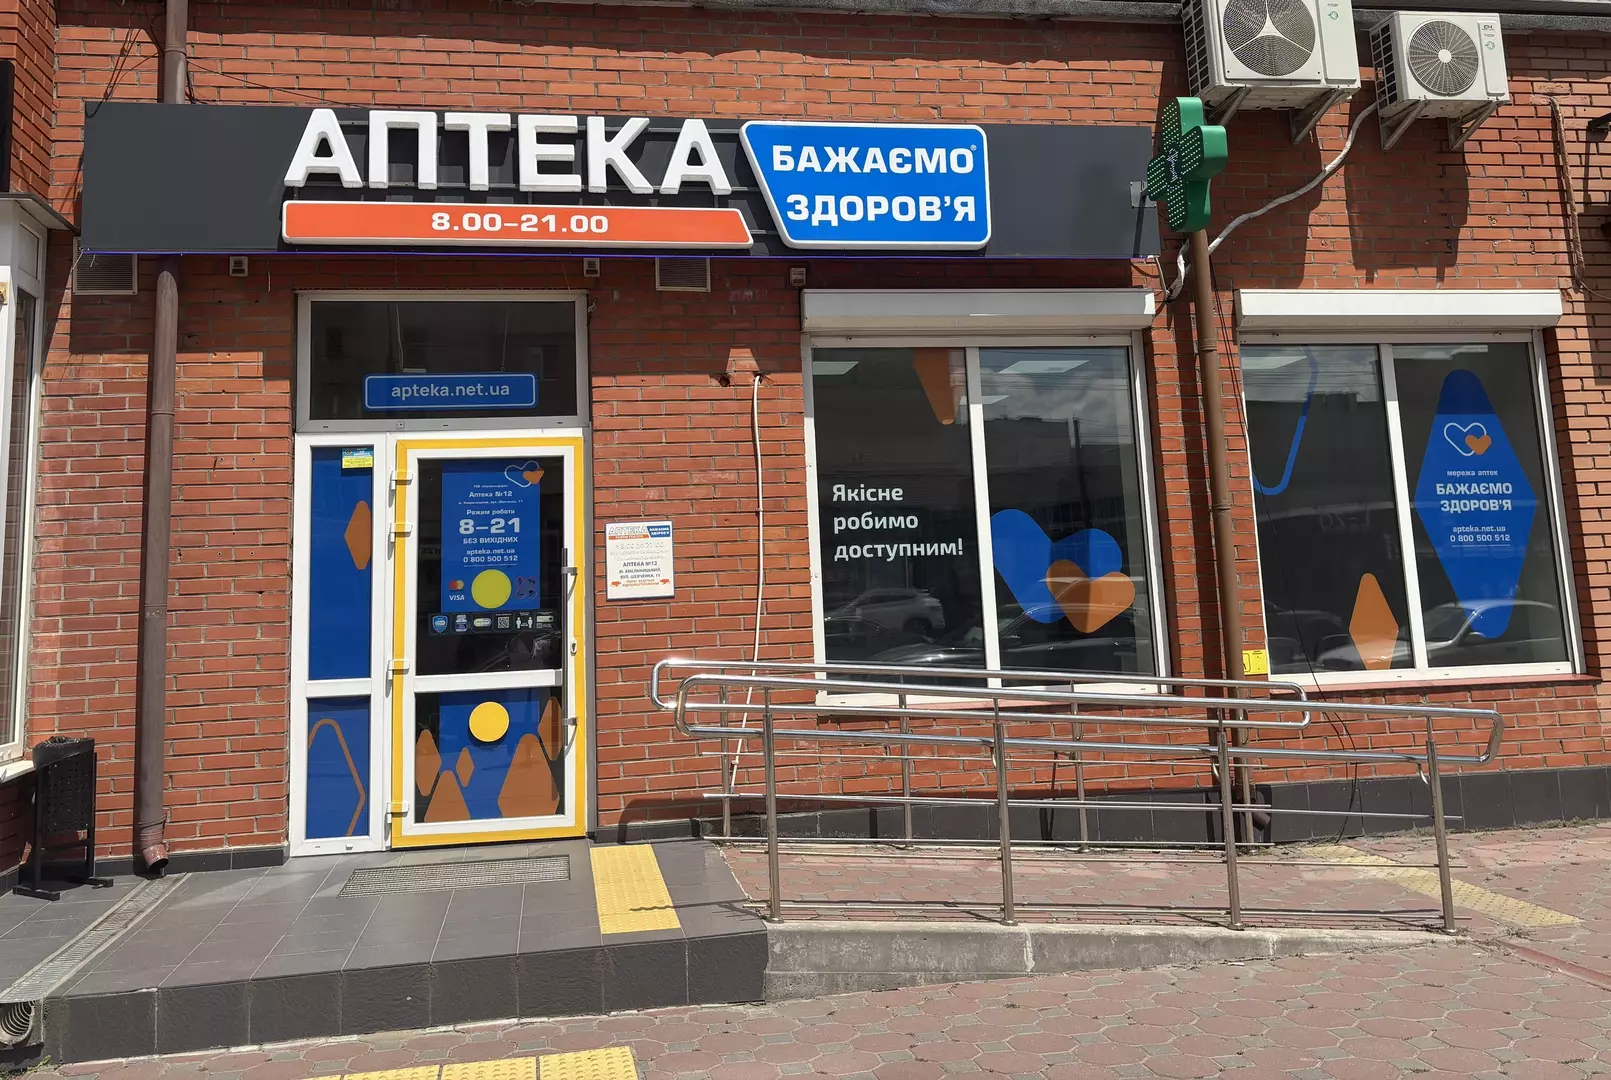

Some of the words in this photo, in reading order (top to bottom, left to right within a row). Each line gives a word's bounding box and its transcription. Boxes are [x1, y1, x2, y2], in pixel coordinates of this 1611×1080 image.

[283, 108, 732, 195] АПТЕКА
[786, 194, 976, 227] ЗДОРОВ’Я
[391, 380, 510, 400] apteka.net.ua
[832, 483, 904, 502] Якісне
[1436, 483, 1513, 495] БАЖАЄМО
[1440, 499, 1512, 514] ЗДОРОВ’Я
[833, 511, 919, 534] робимо
[1452, 525, 1506, 534] apteka.net.ua
[479, 536, 519, 544] ВИХІДНИХ
[1477, 534, 1492, 542] 500
[466, 548, 515, 556] apteka.net.ua
[834, 537, 963, 562] доступним!
